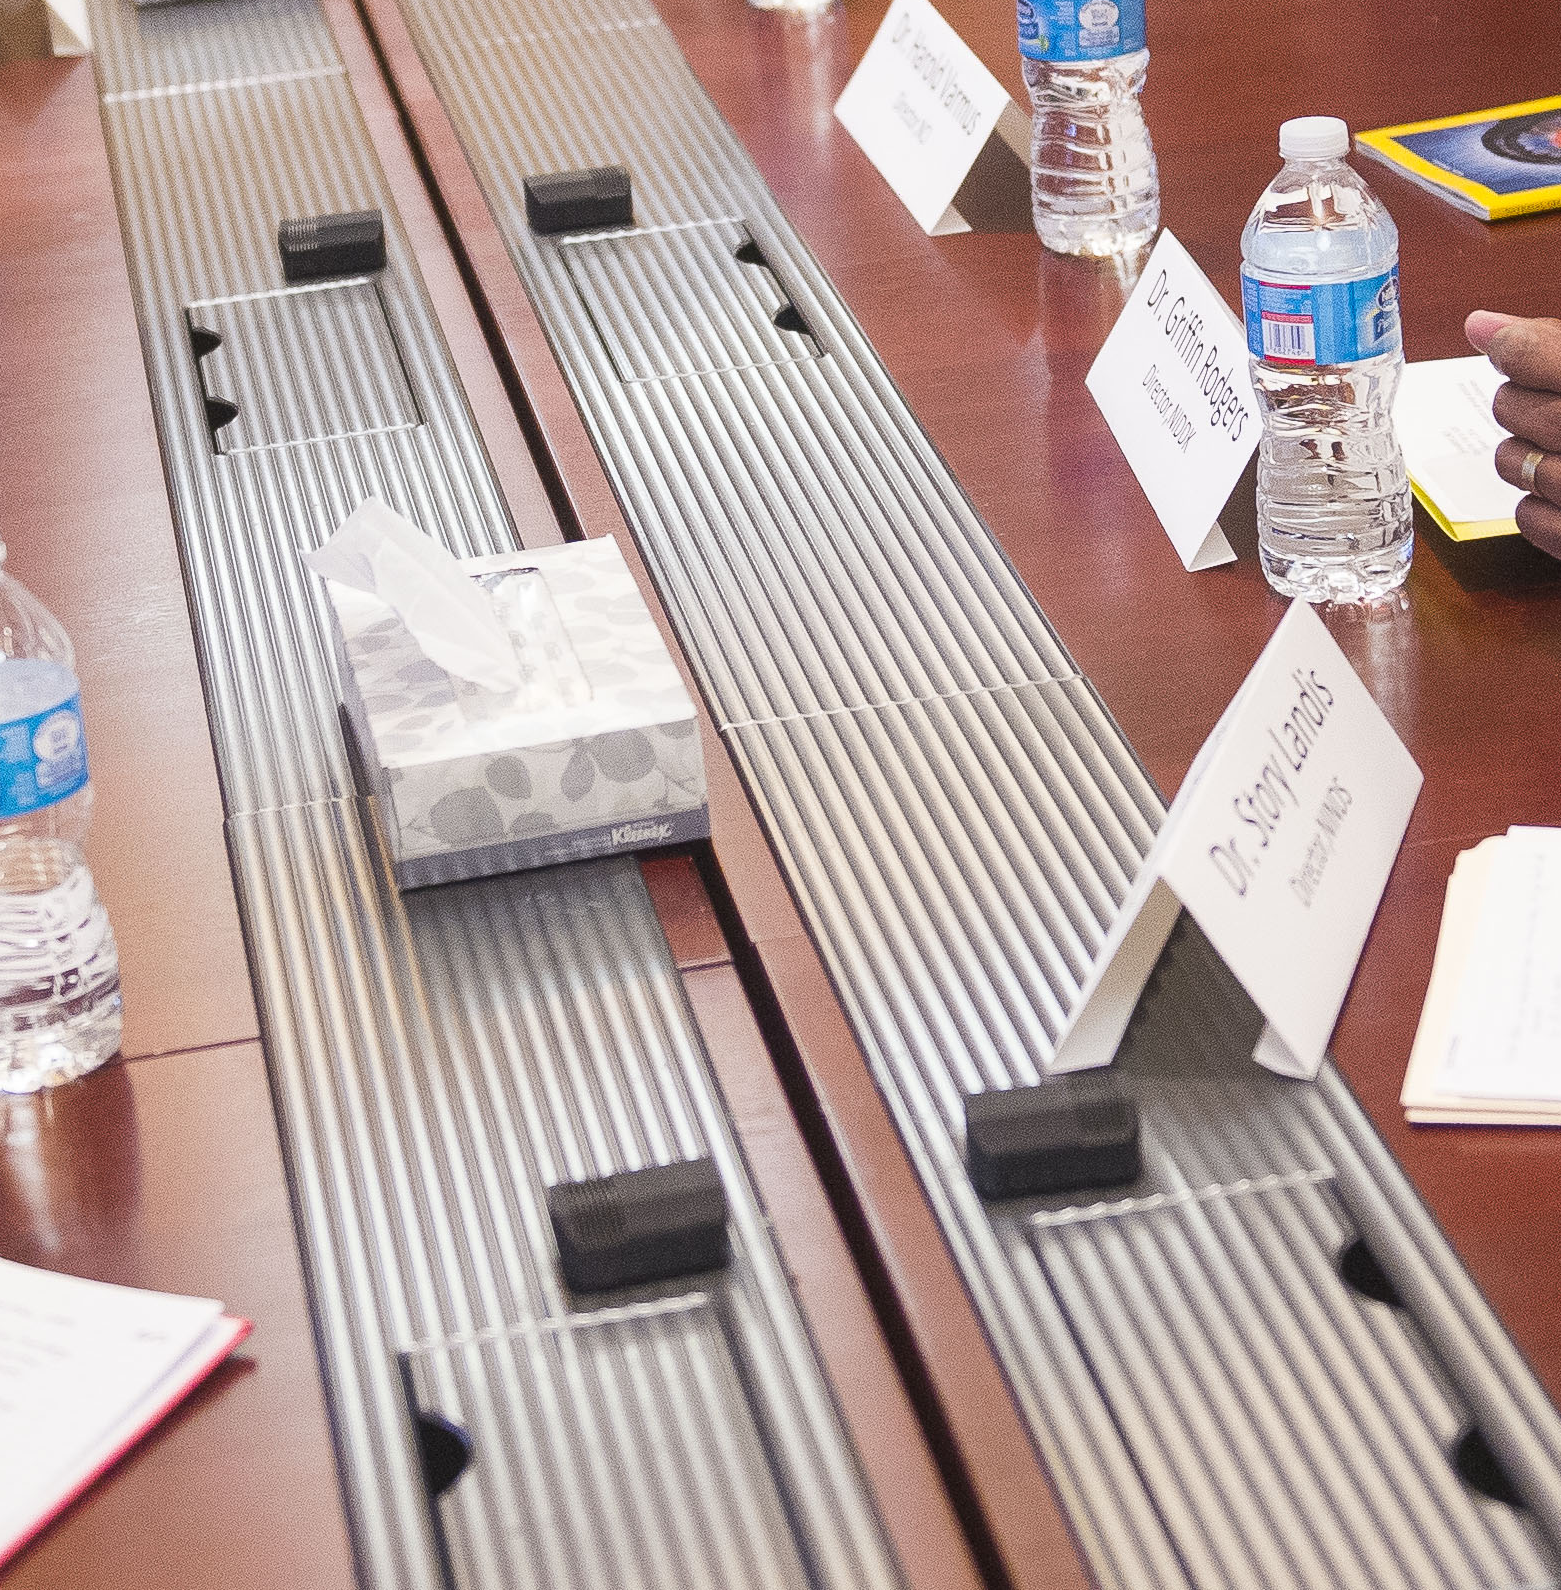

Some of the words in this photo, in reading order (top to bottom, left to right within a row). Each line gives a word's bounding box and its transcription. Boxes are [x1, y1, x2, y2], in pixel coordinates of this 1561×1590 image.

[910, 27, 950, 91] Harold
[938, 67, 982, 137] Varmus
[1147, 268, 1169, 321] Dr.
[1164, 296, 1204, 374] Griffin
[1196, 344, 1249, 442] Rodgers
[1268, 667, 1335, 772] Landis
[1232, 753, 1300, 848] Story
[1209, 837, 1262, 898] Dr.
